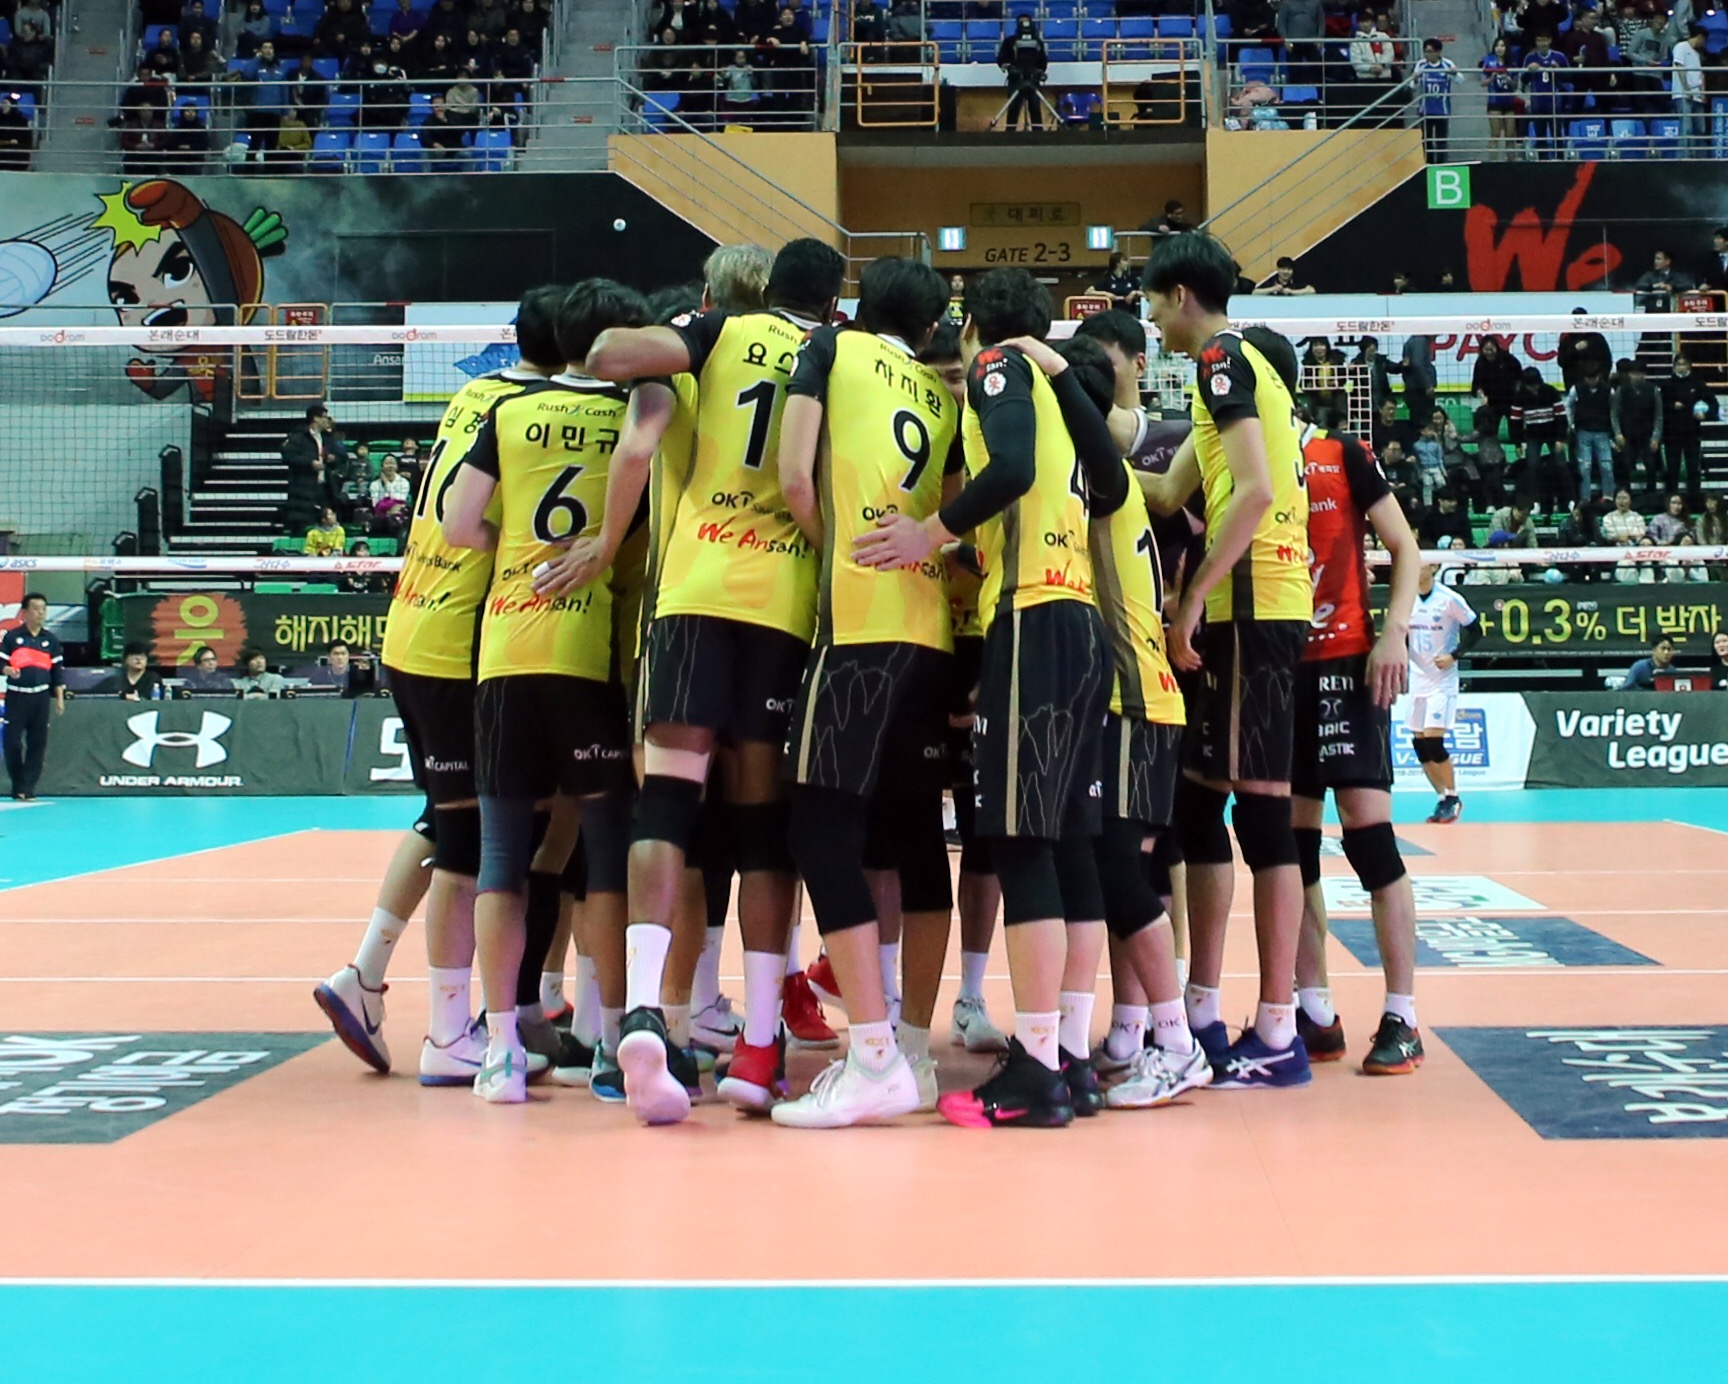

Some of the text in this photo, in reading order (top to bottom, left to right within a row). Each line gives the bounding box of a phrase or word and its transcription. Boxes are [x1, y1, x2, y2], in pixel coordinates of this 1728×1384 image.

[1438, 172, 1461, 204] B
[1465, 162, 1623, 292] We
[985, 243, 1071, 263] GATE 2-3
[537, 402, 617, 418] Rush Cash
[736, 379, 779, 471] 1
[890, 408, 932, 493] 9
[533, 464, 589, 546] 6
[698, 520, 811, 559] We Ansan!
[1616, 611, 1648, 642] 더
[1654, 603, 1723, 645] 받자
[1556, 707, 1684, 742] Variety
[99, 774, 243, 789] UNDER ARMOUR
